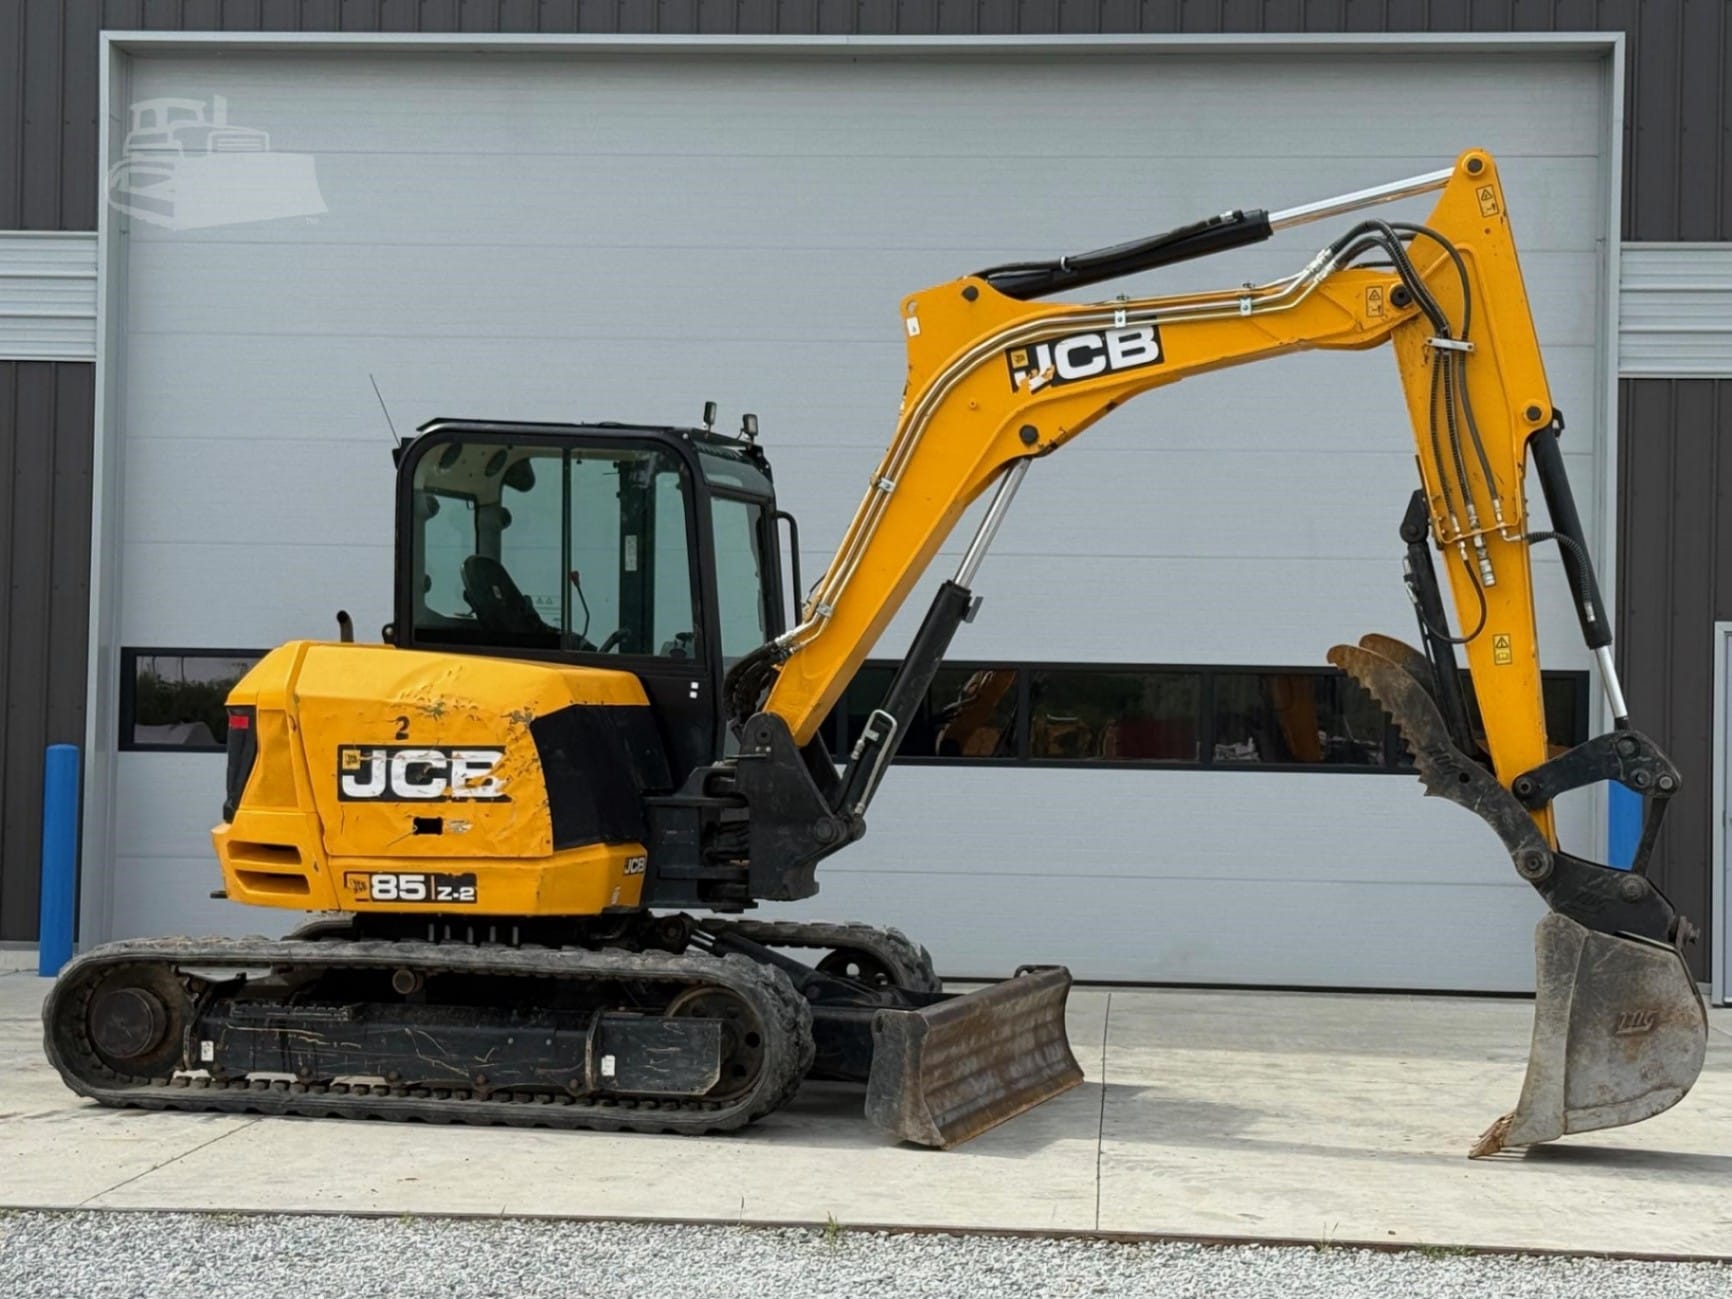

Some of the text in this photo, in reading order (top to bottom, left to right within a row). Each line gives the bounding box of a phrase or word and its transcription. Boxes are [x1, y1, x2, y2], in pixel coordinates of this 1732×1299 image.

[1013, 326, 1160, 391] JCB
[394, 715, 410, 741] 2
[341, 749, 508, 798] JCB
[624, 857, 646, 874] JCB
[371, 874, 427, 900] 85
[437, 886, 475, 901] Z-2
